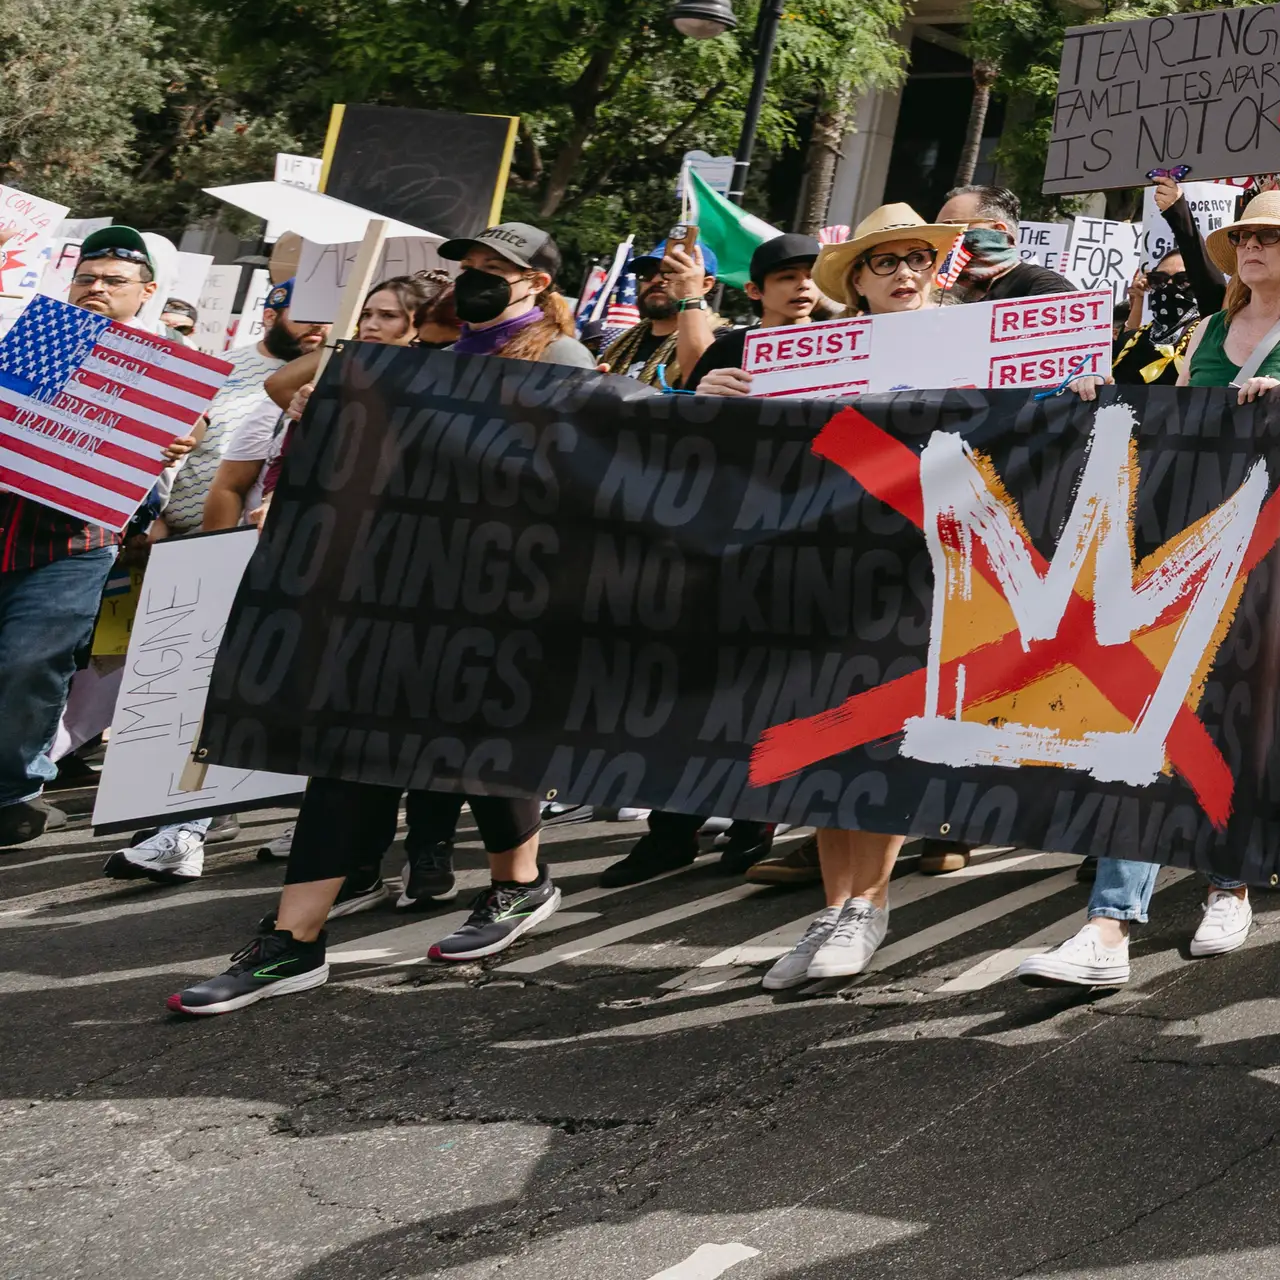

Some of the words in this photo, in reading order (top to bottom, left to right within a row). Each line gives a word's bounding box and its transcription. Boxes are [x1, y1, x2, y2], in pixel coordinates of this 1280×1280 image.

[1064, 7, 1278, 85] TEARING
[1053, 71, 1212, 133] FAMILIES
[1044, 128, 1113, 182] IS
[1136, 98, 1222, 169] NOT
[5, 193, 35, 216] CON
[30, 213, 50, 229] LA
[1189, 199, 1232, 213] OCRACY
[1019, 227, 1050, 246] THE
[1078, 219, 1119, 245] IF
[1072, 245, 1125, 280] FOR
[1002, 301, 1104, 332] RESIST
[77, 318, 172, 365] FIGHTING
[754, 330, 864, 364] RESIST
[1000, 352, 1103, 384] RESIST
[27, 386, 121, 433] AMERICAN
[94, 382, 126, 405] AN
[13, 407, 105, 456] TRADITION
[370, 406, 578, 515] KINGS
[595, 431, 717, 526] NO
[246, 501, 337, 596] NO
[339, 511, 560, 620] KINGS
[584, 533, 686, 631] NO
[115, 577, 202, 746] IMAGINE
[212, 608, 303, 705] NO
[309, 620, 543, 729] KINGS
[565, 637, 678, 739] NO
